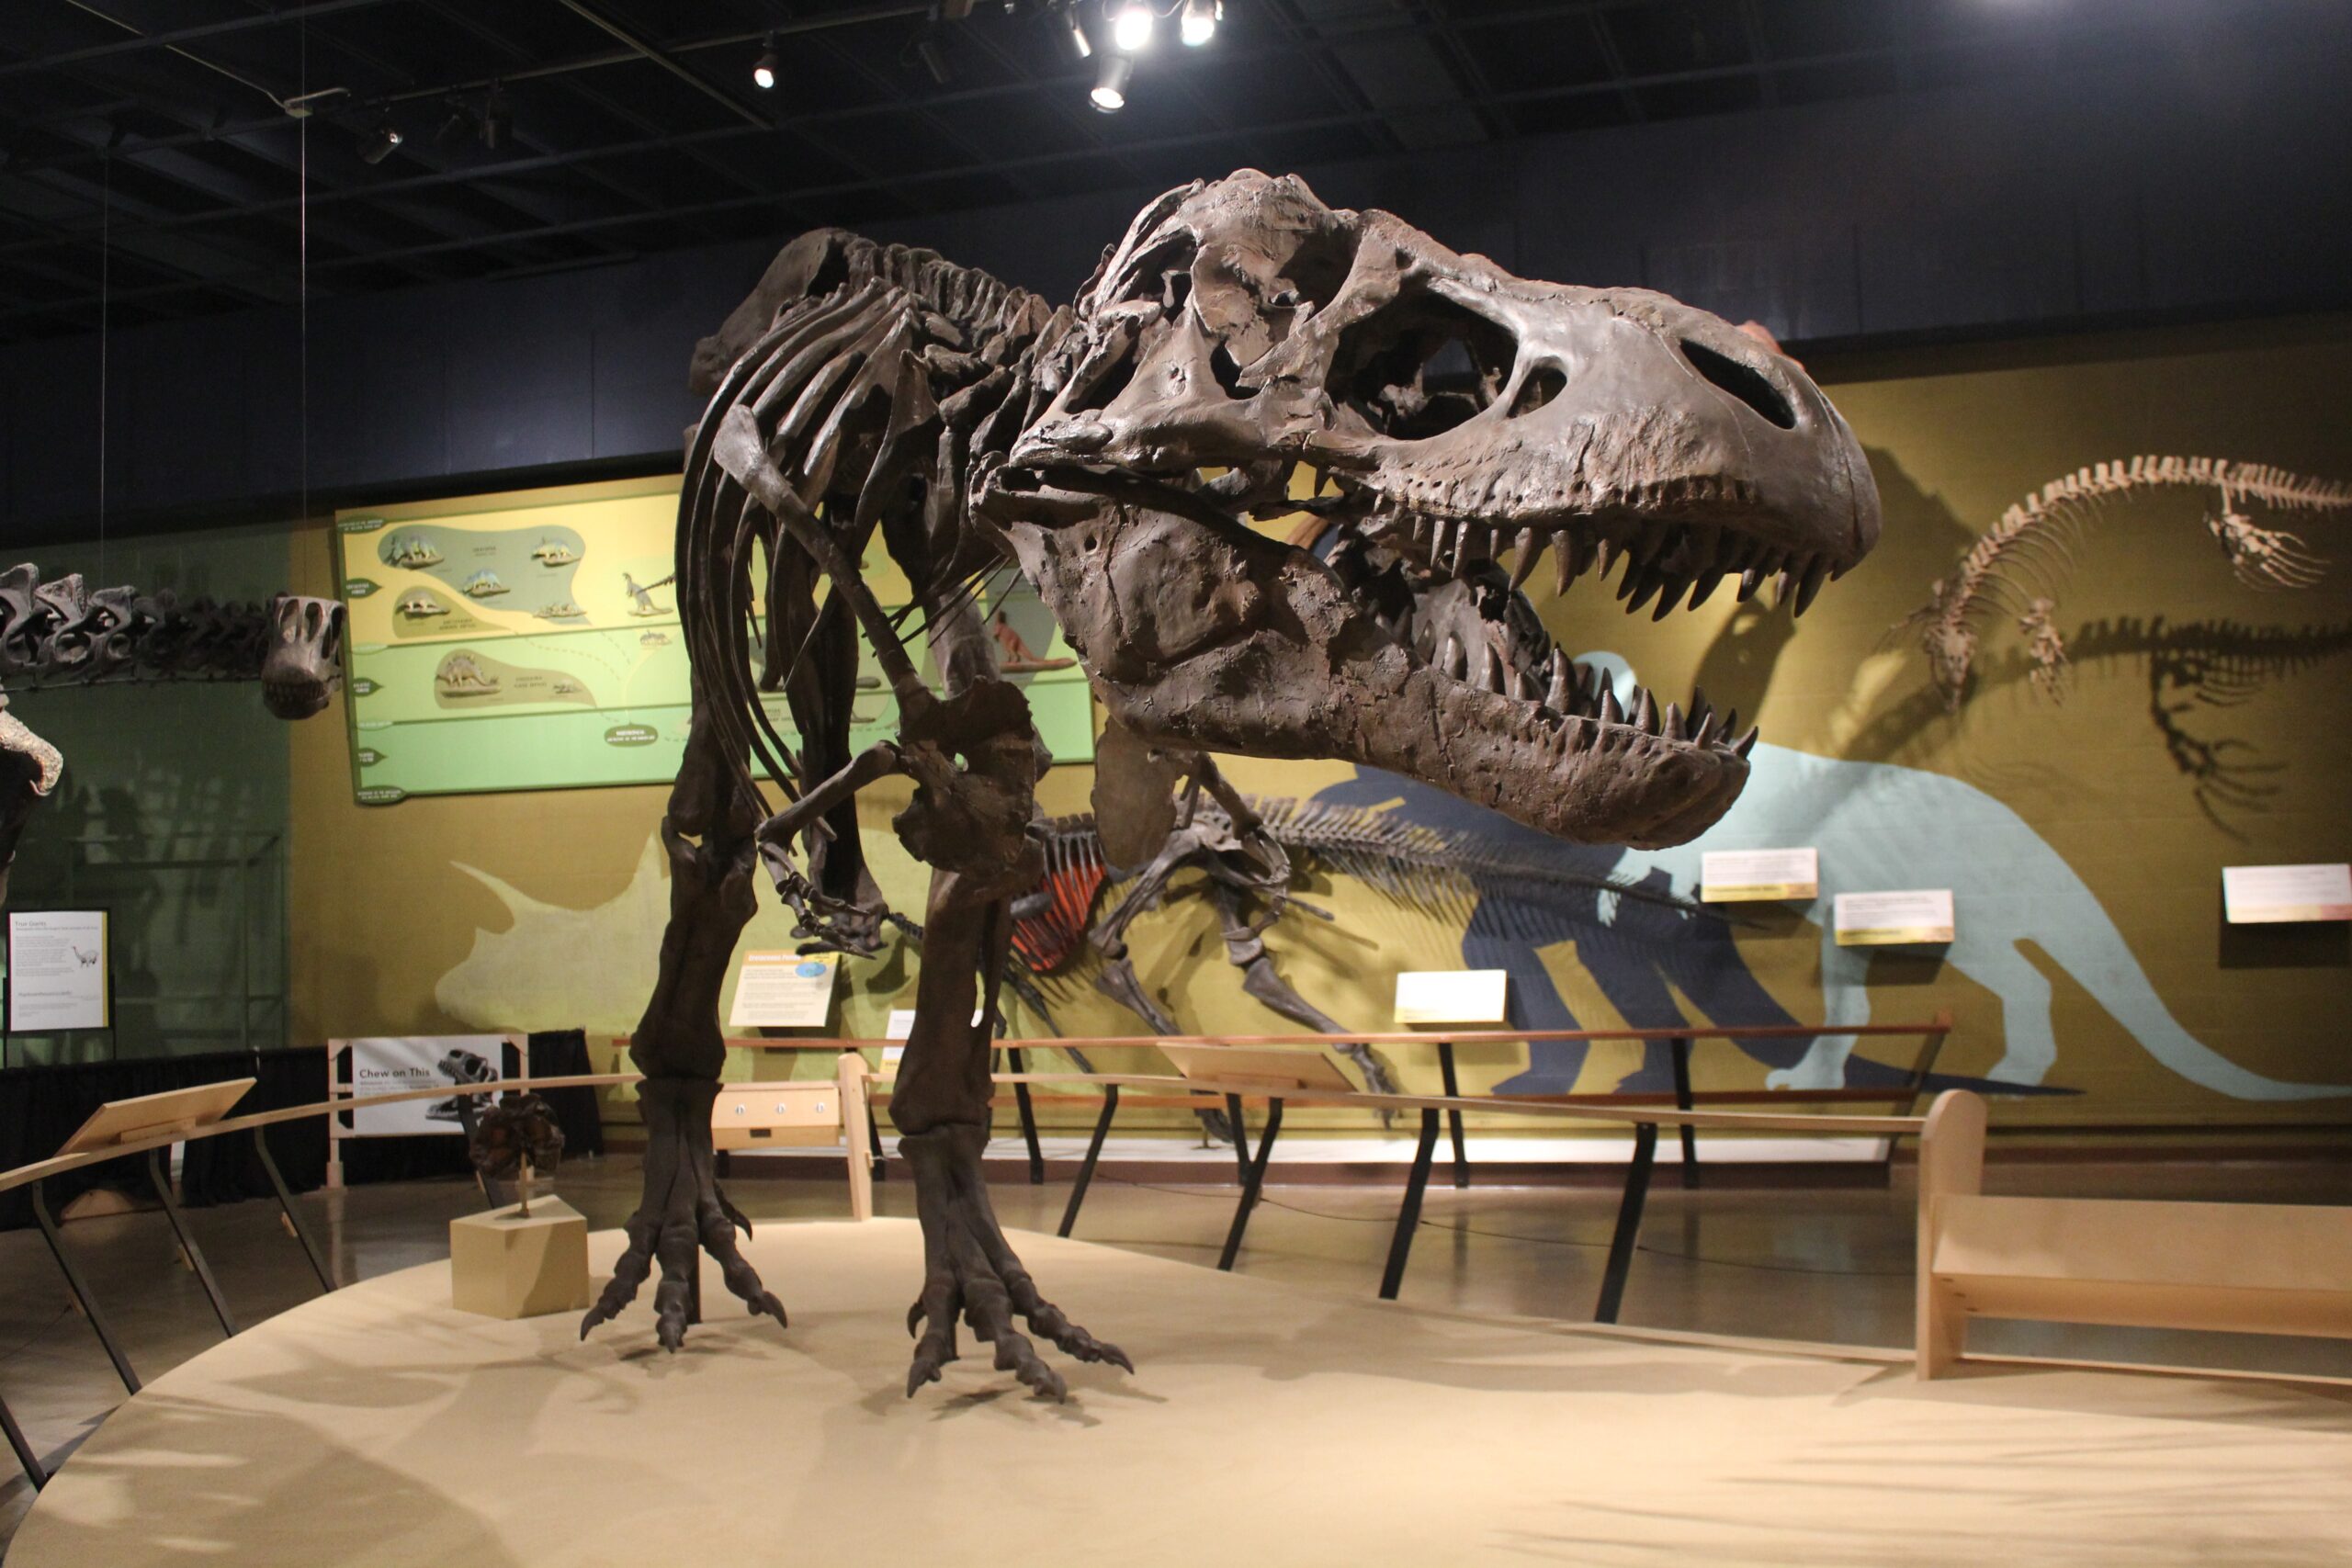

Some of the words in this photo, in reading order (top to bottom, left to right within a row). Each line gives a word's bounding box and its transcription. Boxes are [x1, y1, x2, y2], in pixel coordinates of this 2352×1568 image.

[360, 1069, 389, 1078] Chew
[392, 1069, 406, 1077] on
[410, 1067, 430, 1077] This
